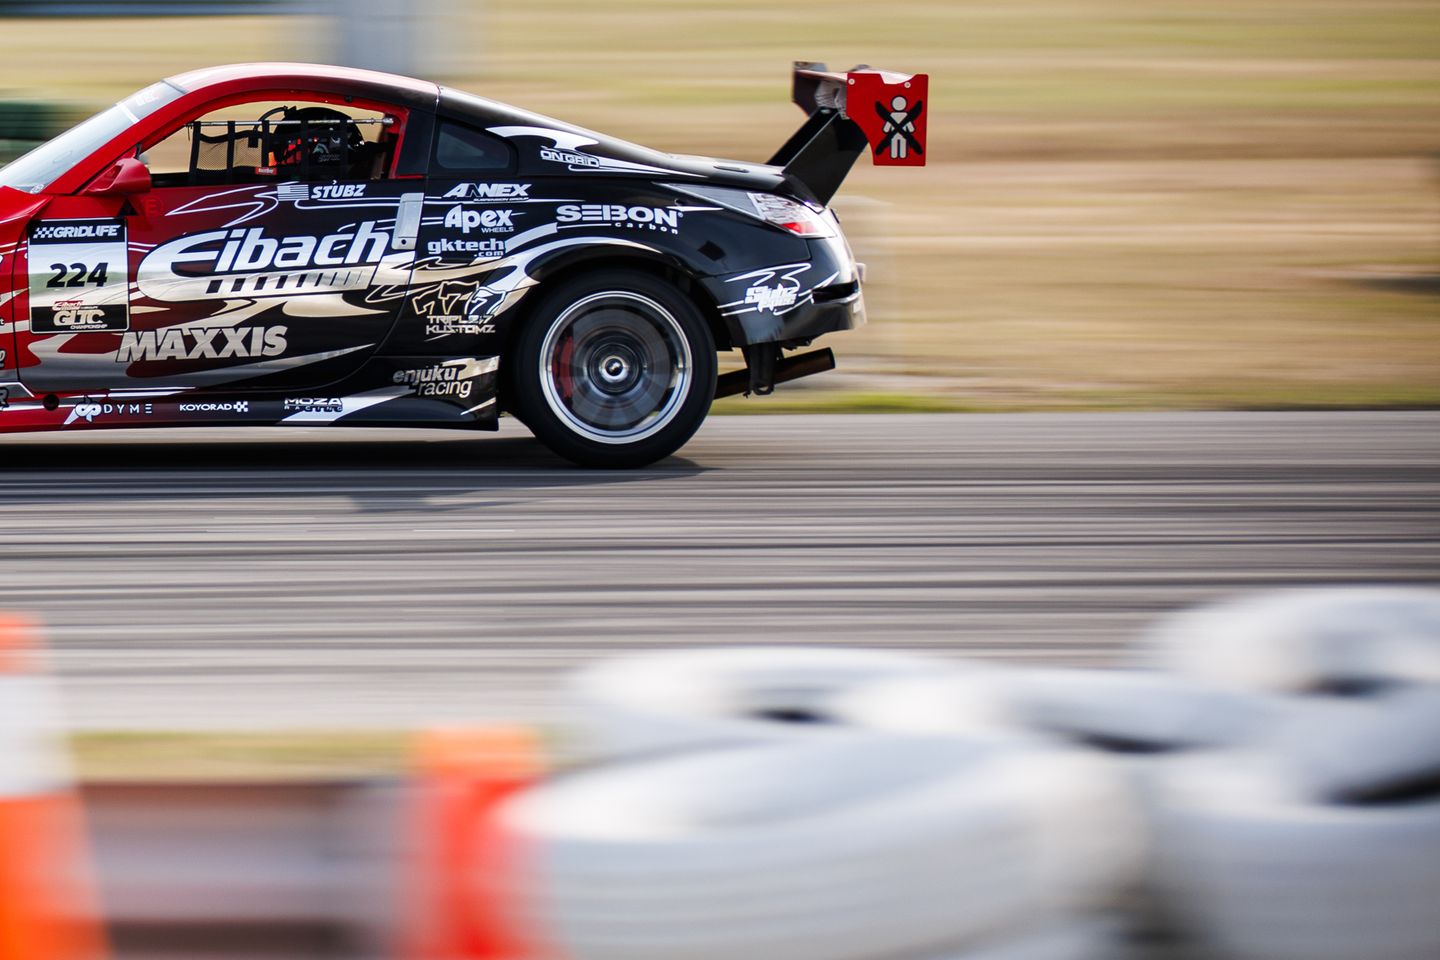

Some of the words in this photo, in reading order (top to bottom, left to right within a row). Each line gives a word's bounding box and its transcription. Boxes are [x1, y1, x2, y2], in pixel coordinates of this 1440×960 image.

[445, 205, 513, 233] Apex
[53, 225, 121, 238] GRIDLIFE
[614, 221, 679, 235] carbon
[427, 238, 504, 255] gktech
[137, 221, 389, 302] Eibach
[46, 262, 108, 288] 224
[53, 309, 106, 326] GLTC
[116, 325, 288, 363] MAXXIS
[393, 365, 458, 385] enjuku
[418, 380, 473, 398] racing
[179, 403, 232, 411] KOYORAD
[284, 397, 342, 406] MOZA
